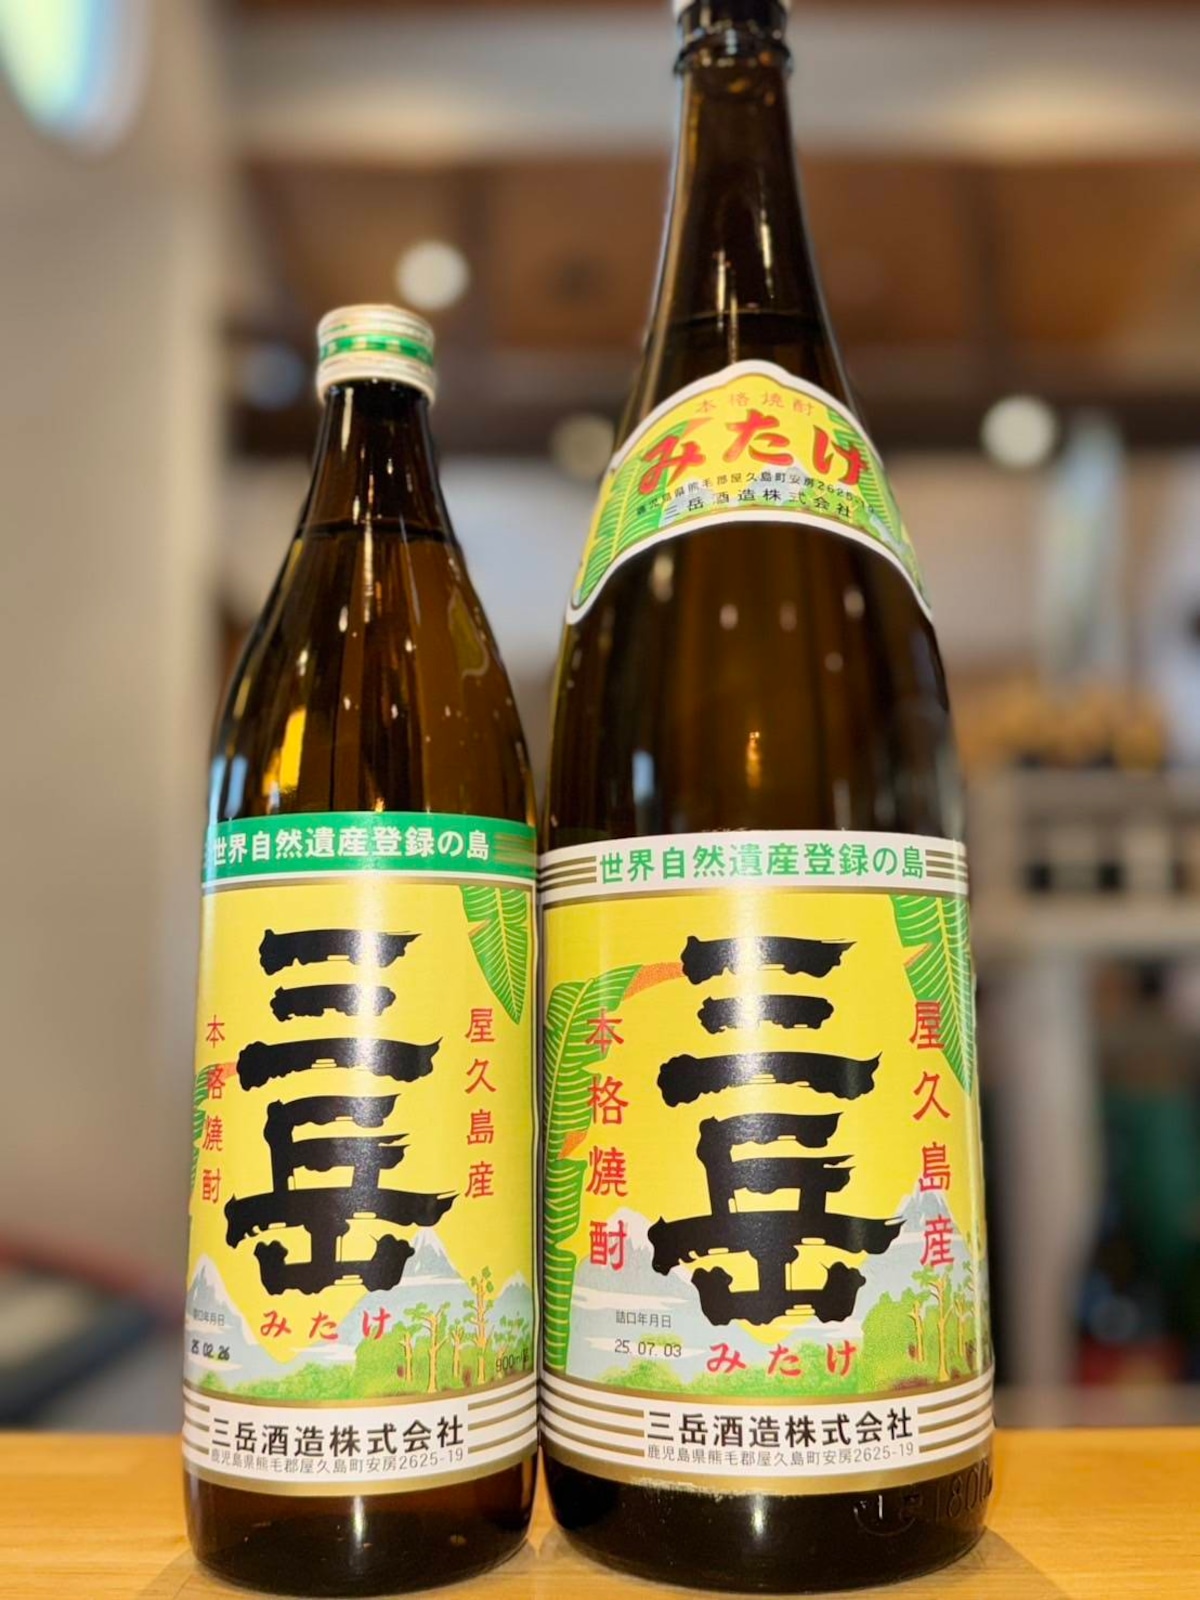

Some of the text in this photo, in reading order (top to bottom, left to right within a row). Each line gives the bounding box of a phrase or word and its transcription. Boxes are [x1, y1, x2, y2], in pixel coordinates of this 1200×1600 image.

[638, 408, 868, 496] みたけ
[663, 488, 852, 520] 三岳酒造株式会社
[213, 825, 490, 866] 世界自然遺産登録の島
[600, 842, 924, 884] 世界自然遺産登録の島
[224, 929, 460, 1295] 三岳
[465, 1008, 497, 1199] 屋久島産
[648, 935, 905, 1326] 三岳
[909, 1001, 956, 1268] 屋久島産
[260, 1307, 392, 1341] みたけ
[616, 1309, 672, 1329] 詰口年月日
[706, 1339, 857, 1376] みたけ
[211, 1414, 465, 1458] 三岳酒造株式会社
[647, 1408, 914, 1448] 三岳酒造株式会社
